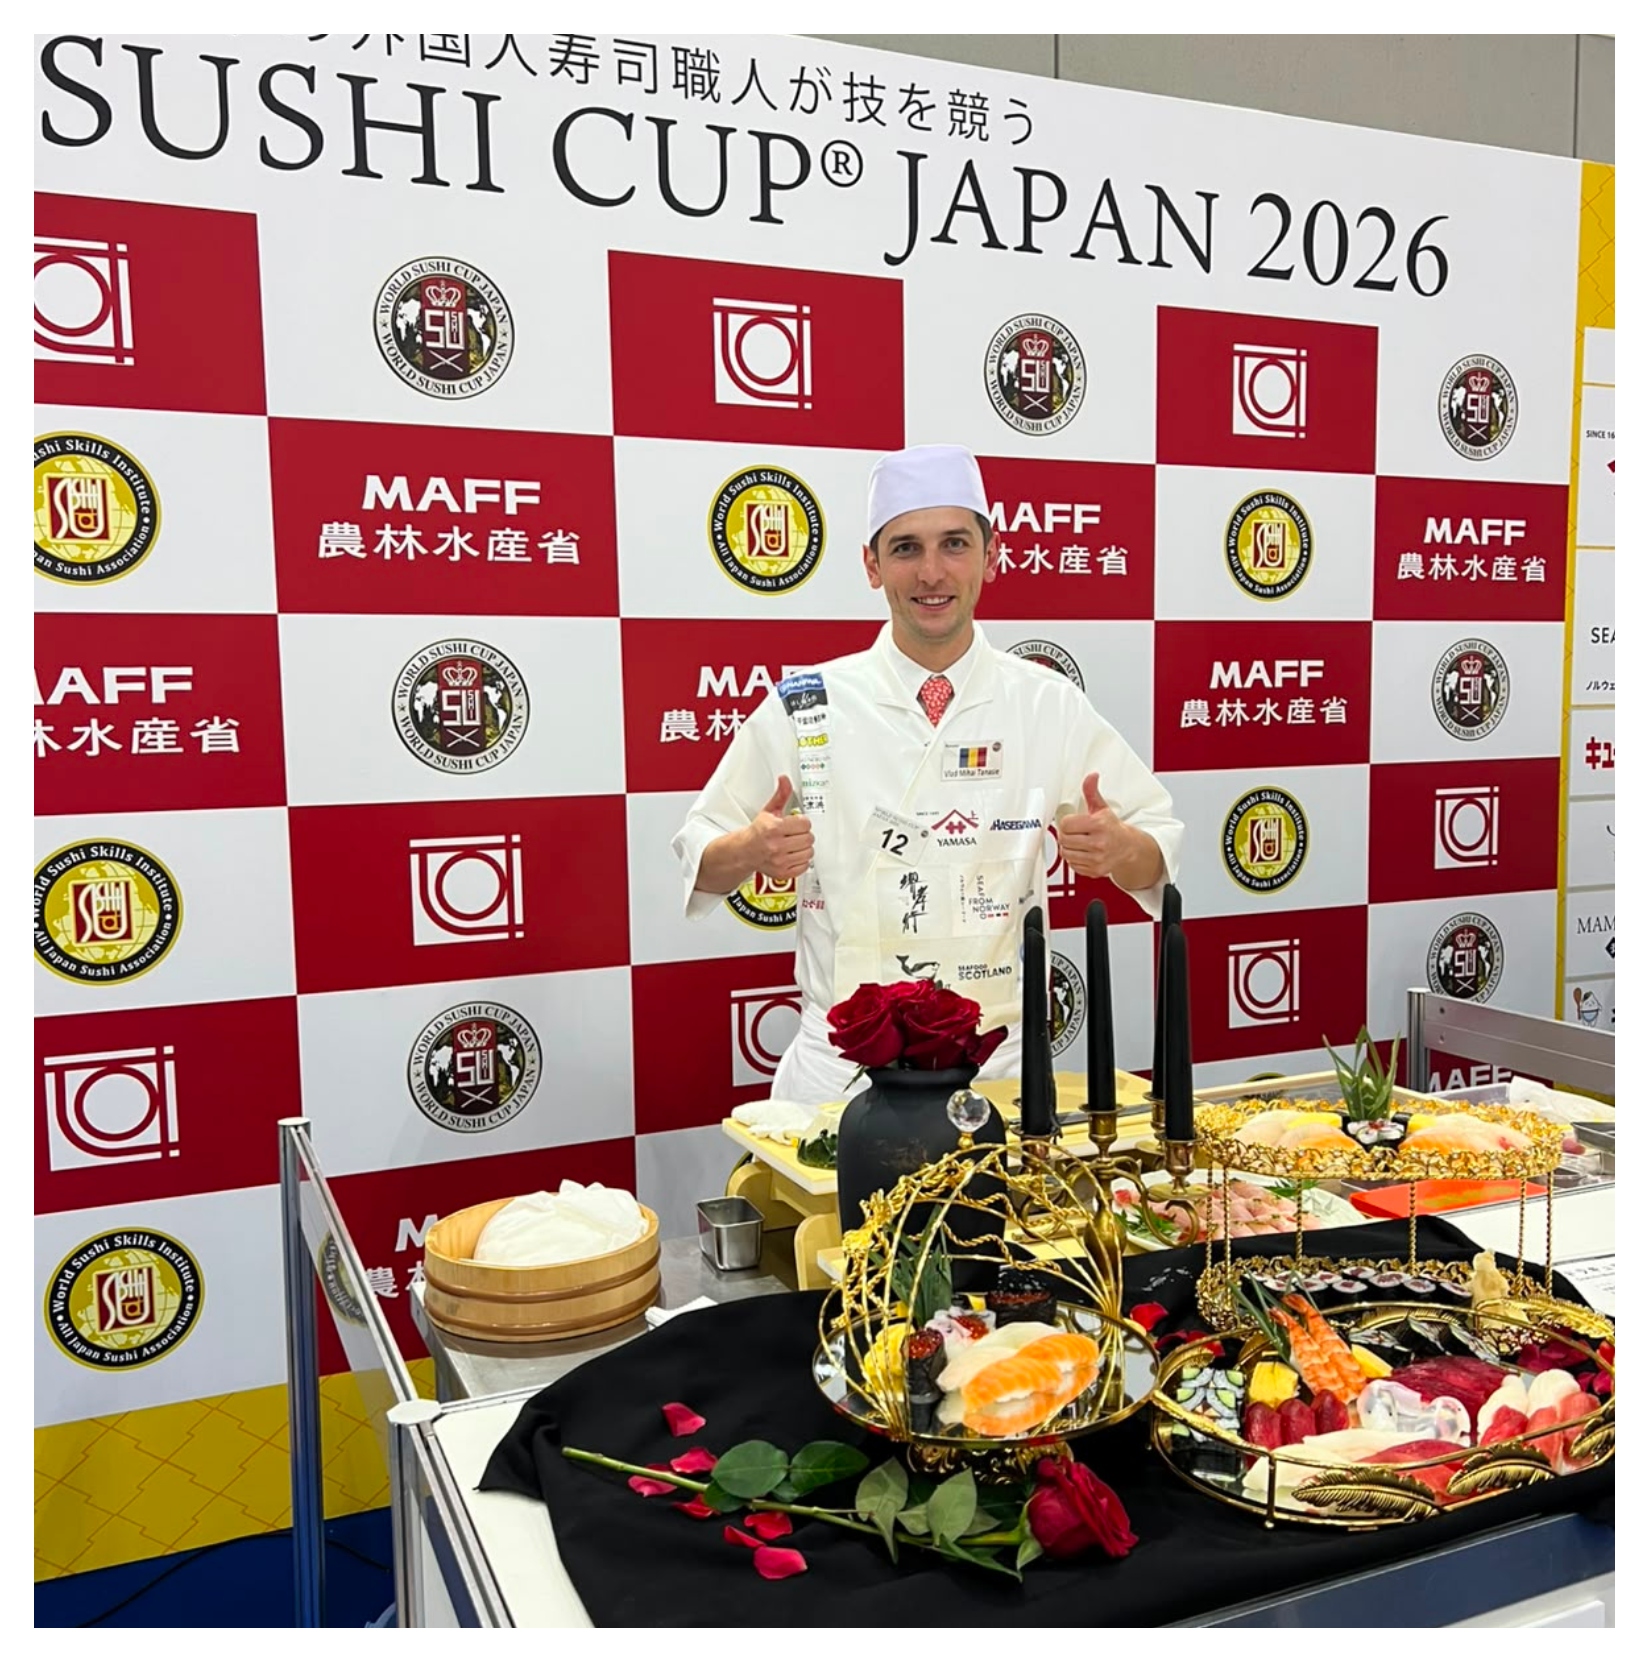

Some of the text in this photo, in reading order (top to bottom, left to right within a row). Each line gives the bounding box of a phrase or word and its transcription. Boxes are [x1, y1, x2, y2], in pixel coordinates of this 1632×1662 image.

[40, 34, 505, 193] SUSHI
[884, 150, 1219, 274] JAPAN
[1246, 193, 1449, 297] 2026
[380, 262, 507, 323] WORLD SUSHI CUP JAPAN
[383, 334, 507, 394] WORLD SUSHI CUP JAPAN
[66, 440, 110, 458] Skills
[112, 455, 150, 514] Institute
[362, 475, 541, 515] MAFF
[714, 472, 819, 534] World Sushi Skills Institute
[56, 562, 92, 575] Sushi
[97, 526, 149, 574] Association
[318, 522, 580, 564] 農林水産省
[1424, 517, 1526, 545] MAFF
[718, 542, 817, 586] All Japan Sushi Association
[1397, 552, 1546, 582] 農林水産省
[398, 644, 521, 698] WORLD SUSHI CUP JAPAN
[1210, 660, 1324, 689] MAFF
[1180, 696, 1347, 728] 農林水産省
[401, 715, 522, 769] WORLD SUSHI CUP JAPAN
[881, 828, 909, 856] 12
[937, 837, 977, 847] YAMASA
[48, 849, 86, 876] Sushi
[90, 846, 133, 861] Skills
[136, 857, 172, 910] Institute
[972, 903, 1010, 913] NORWAY
[34, 923, 171, 976] All Japan Sushi Association
[957, 966, 1013, 981] SCOTLAND
[413, 1006, 534, 1064] WORLD SUSHI CUP JAPAN
[416, 1070, 535, 1128] WORLD SUSHI CUP JAPAN
[53, 1234, 194, 1312] World Sushi Skills Institute
[59, 1303, 193, 1362] All Japan Sushi Association
